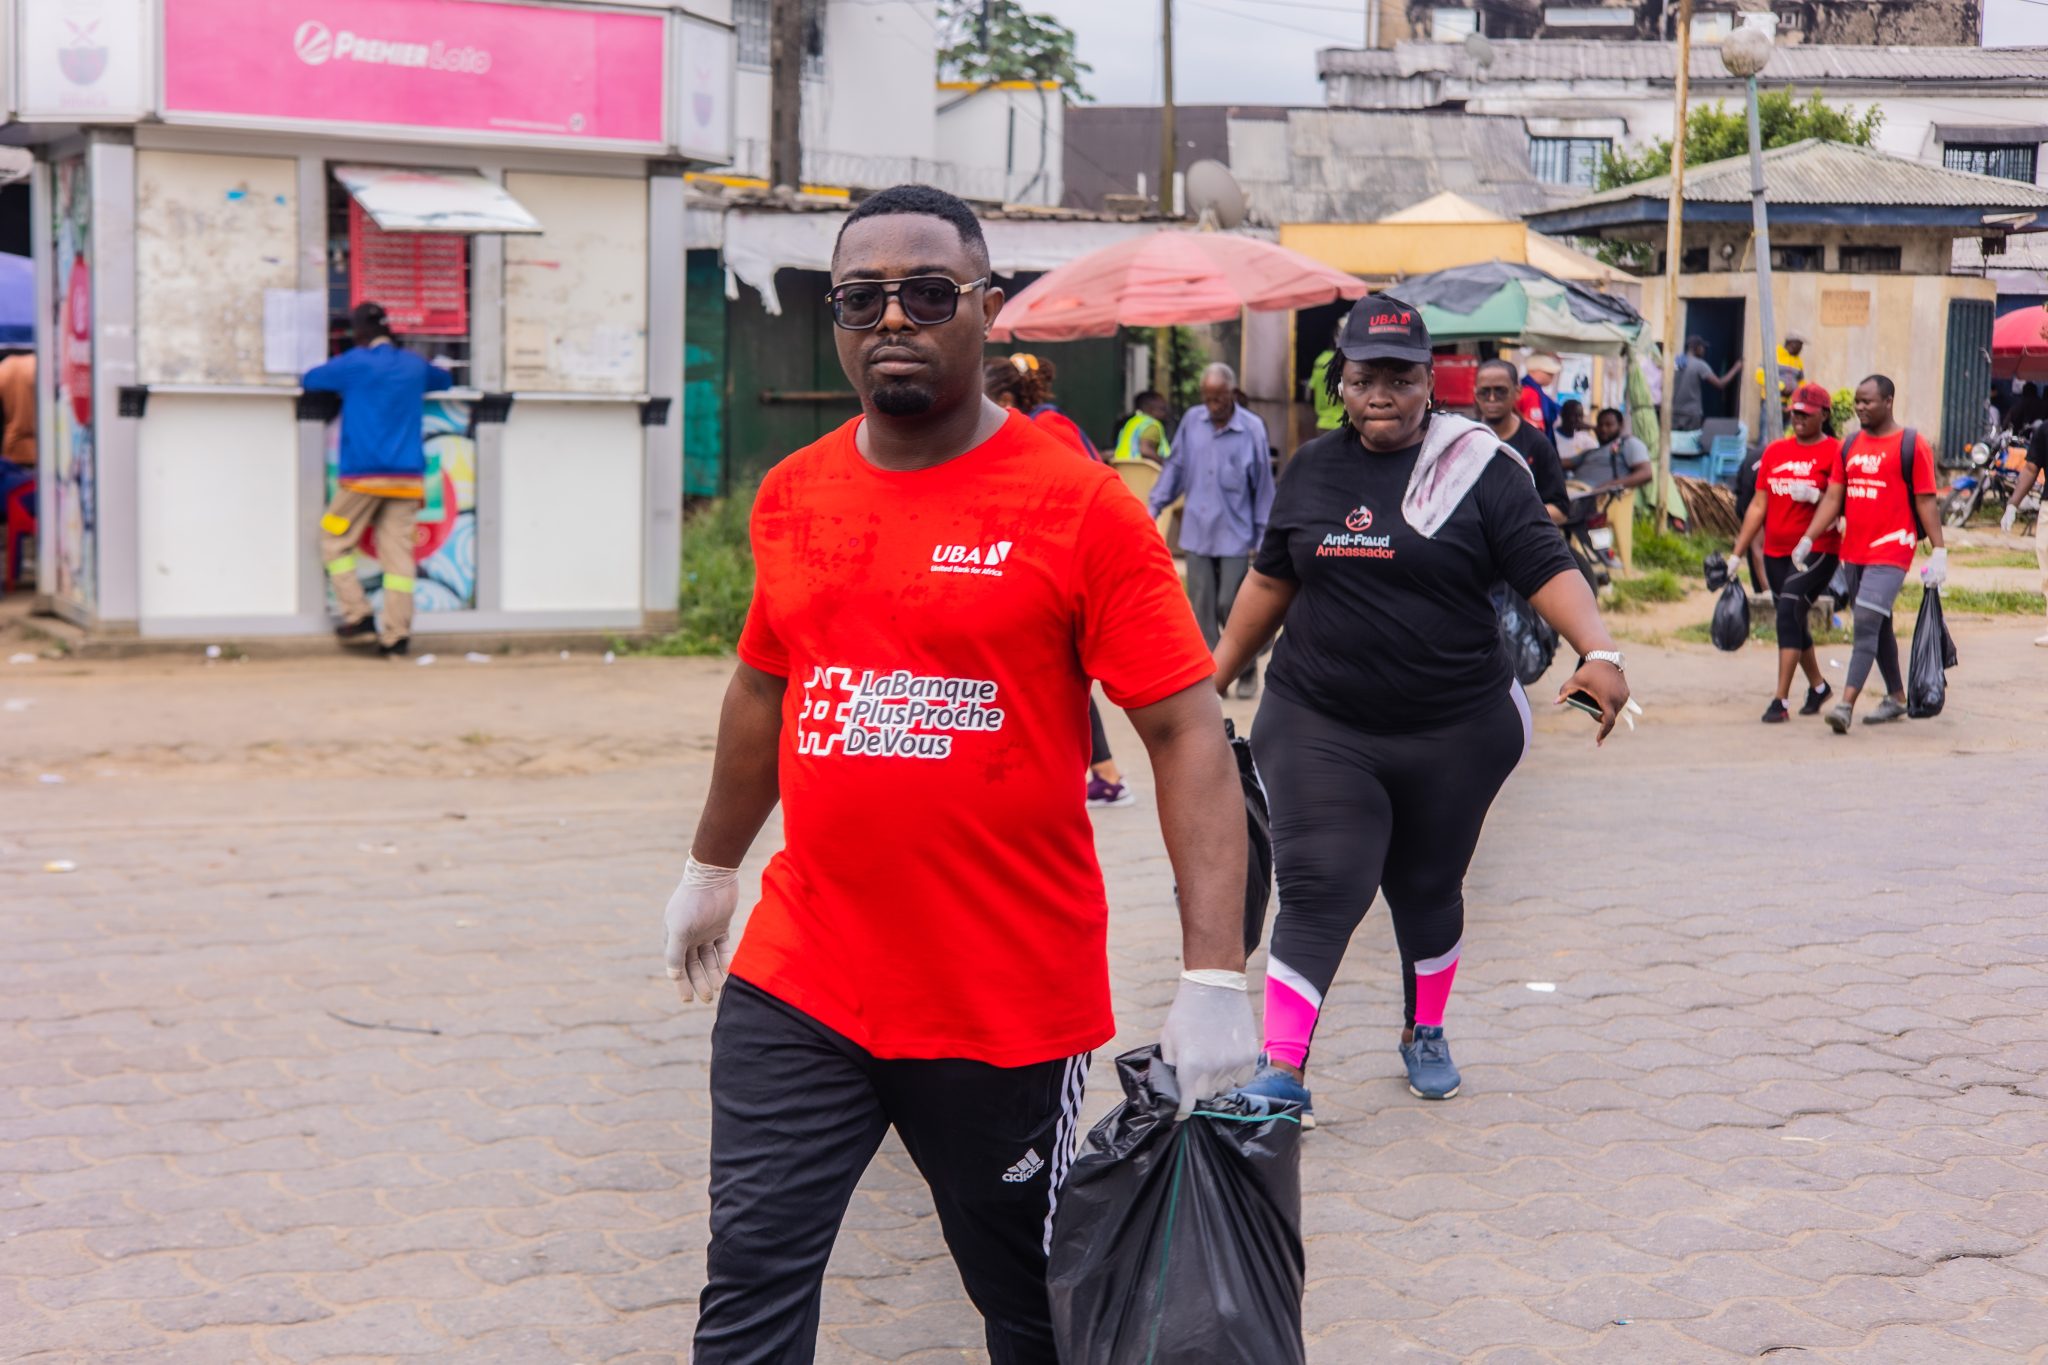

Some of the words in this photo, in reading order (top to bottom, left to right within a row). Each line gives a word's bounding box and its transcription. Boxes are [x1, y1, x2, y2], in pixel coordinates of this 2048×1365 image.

[333, 31, 429, 67] PREMIER
[1369, 314, 1398, 327] UBA
[1315, 544, 1396, 559] Ambassador
[1322, 533, 1390, 548] Anti-Fraud
[932, 544, 981, 565] UBA
[930, 565, 953, 573] United
[953, 565, 970, 574] Bank
[970, 566, 982, 575] for
[981, 567, 1003, 577] Africa
[859, 672, 996, 706] LaBanque
[851, 699, 1003, 731] PlusProche
[845, 726, 950, 758] DeVous
[1002, 1159, 1045, 1183] adidas
